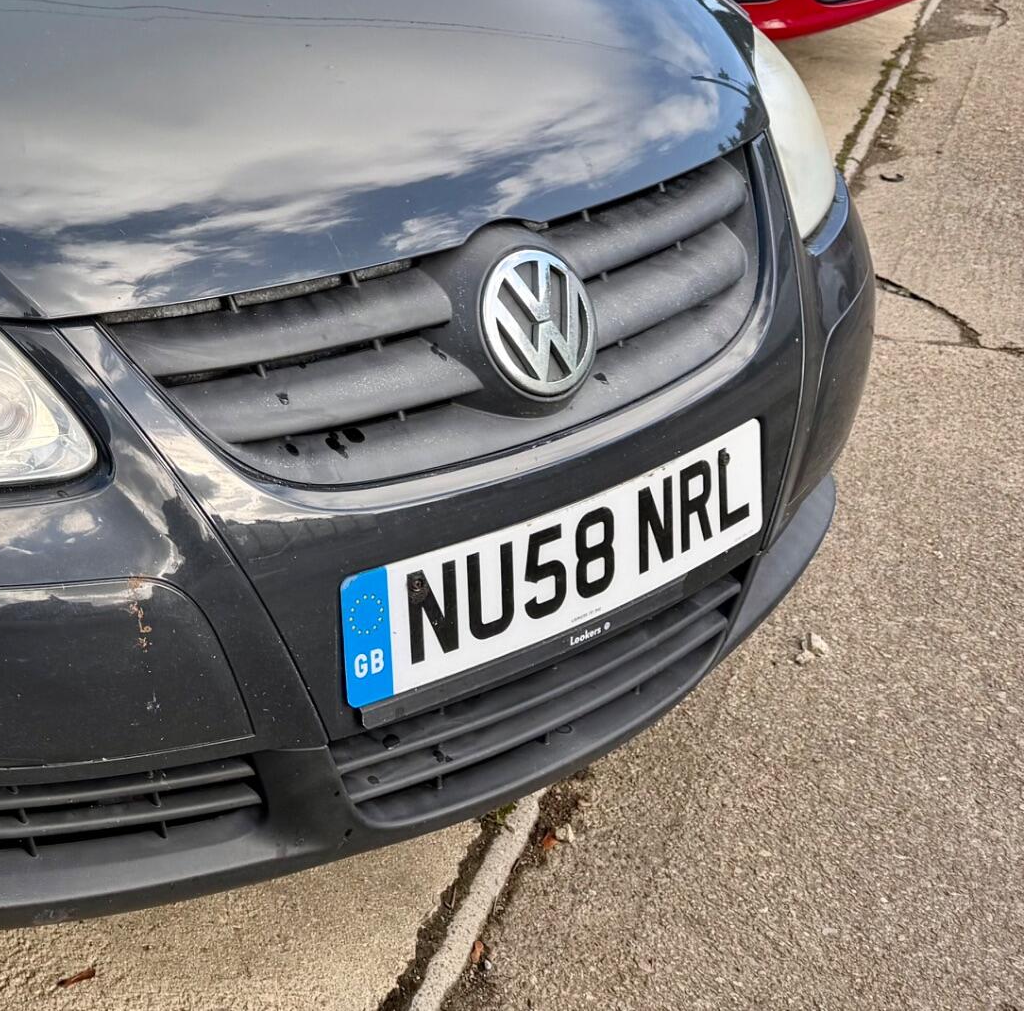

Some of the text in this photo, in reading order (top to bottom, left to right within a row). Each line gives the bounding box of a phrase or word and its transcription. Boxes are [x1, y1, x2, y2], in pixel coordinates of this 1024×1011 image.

[406, 447, 751, 665] NU58 NRL
[569, 626, 602, 647] Lookers
[354, 648, 385, 680] GB
